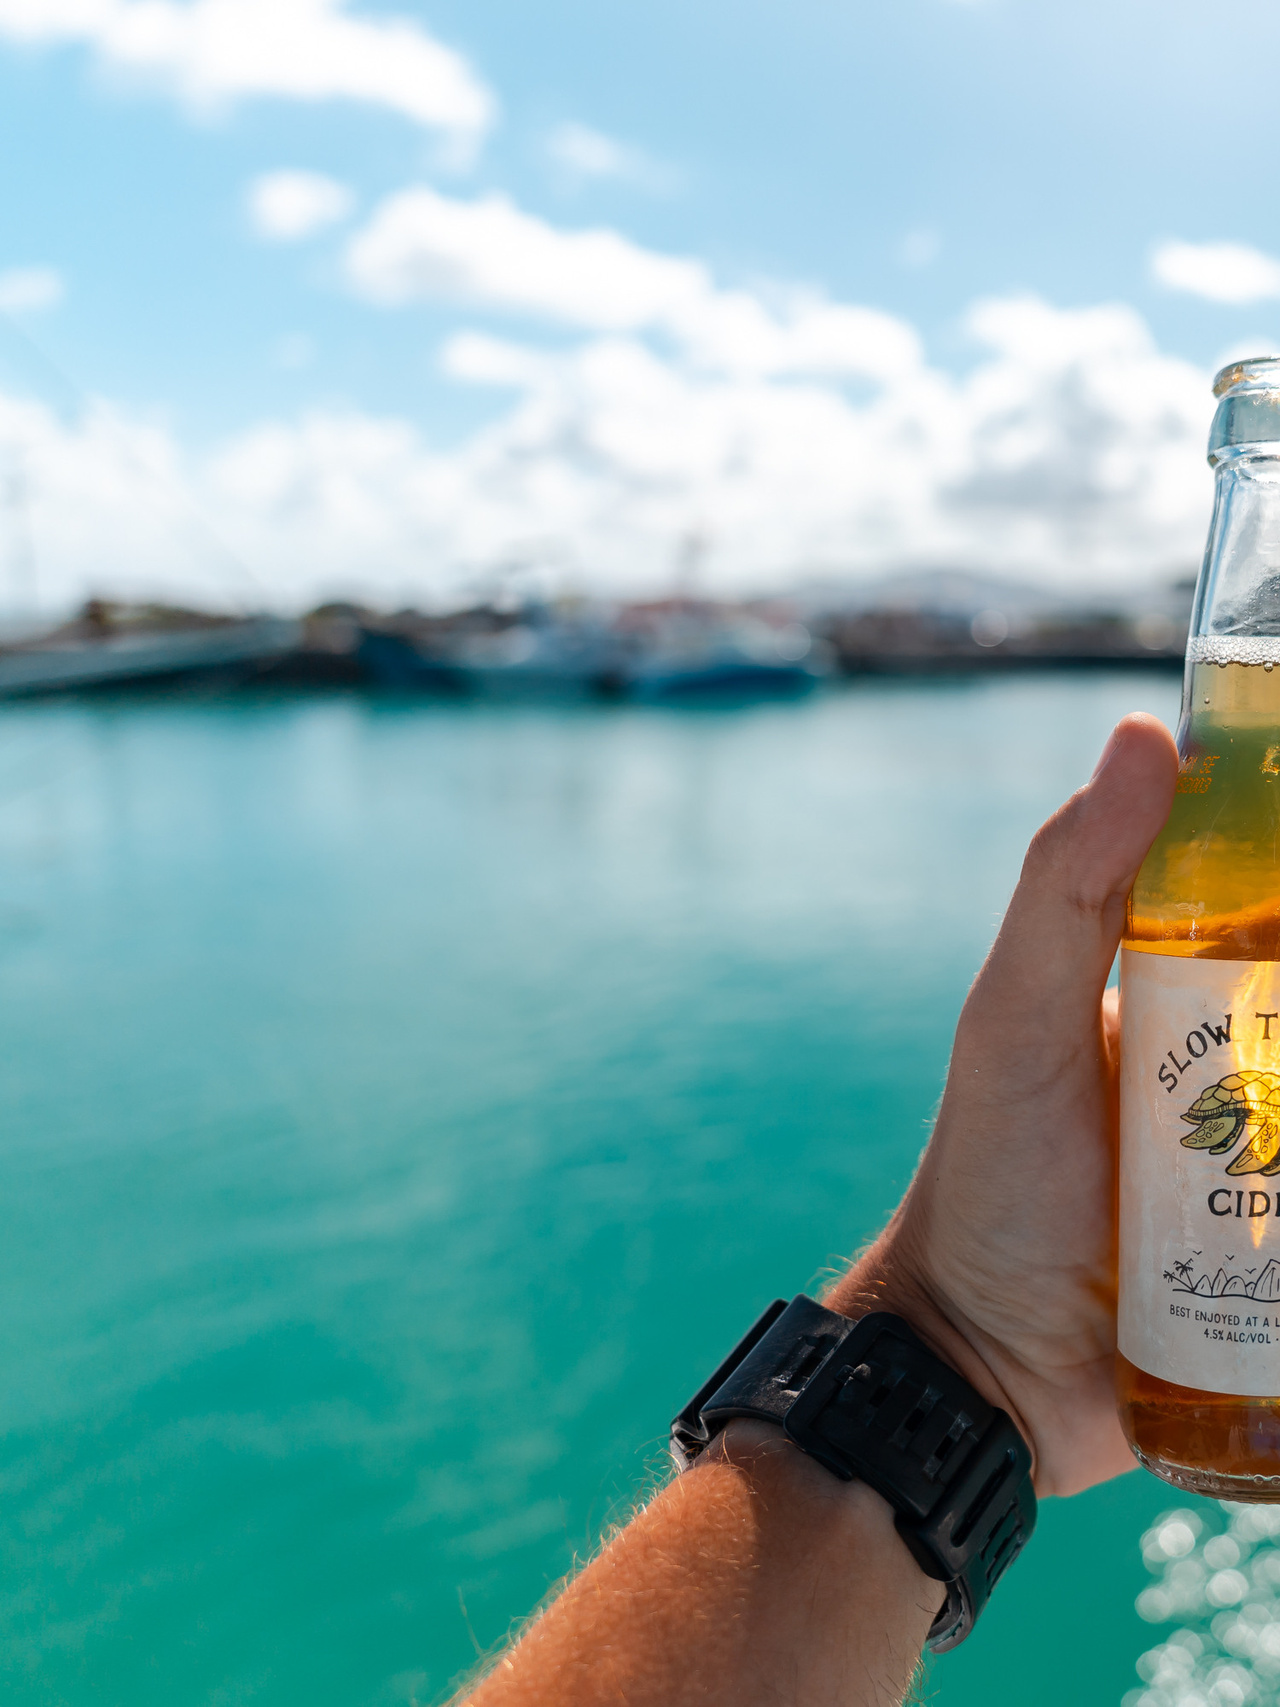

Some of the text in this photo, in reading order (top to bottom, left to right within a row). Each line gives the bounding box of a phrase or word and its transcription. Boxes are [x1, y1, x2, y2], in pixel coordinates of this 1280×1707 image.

[1158, 1014, 1232, 1094] SLOW
[1169, 1304, 1191, 1319] BEST
[1195, 1310, 1240, 1326] ENJOYED
[1245, 1316, 1257, 1327] AT
[1262, 1317, 1269, 1327] A
[1204, 1328, 1224, 1341] 4.5%
[1226, 1333, 1271, 1344] ALC/VOL
